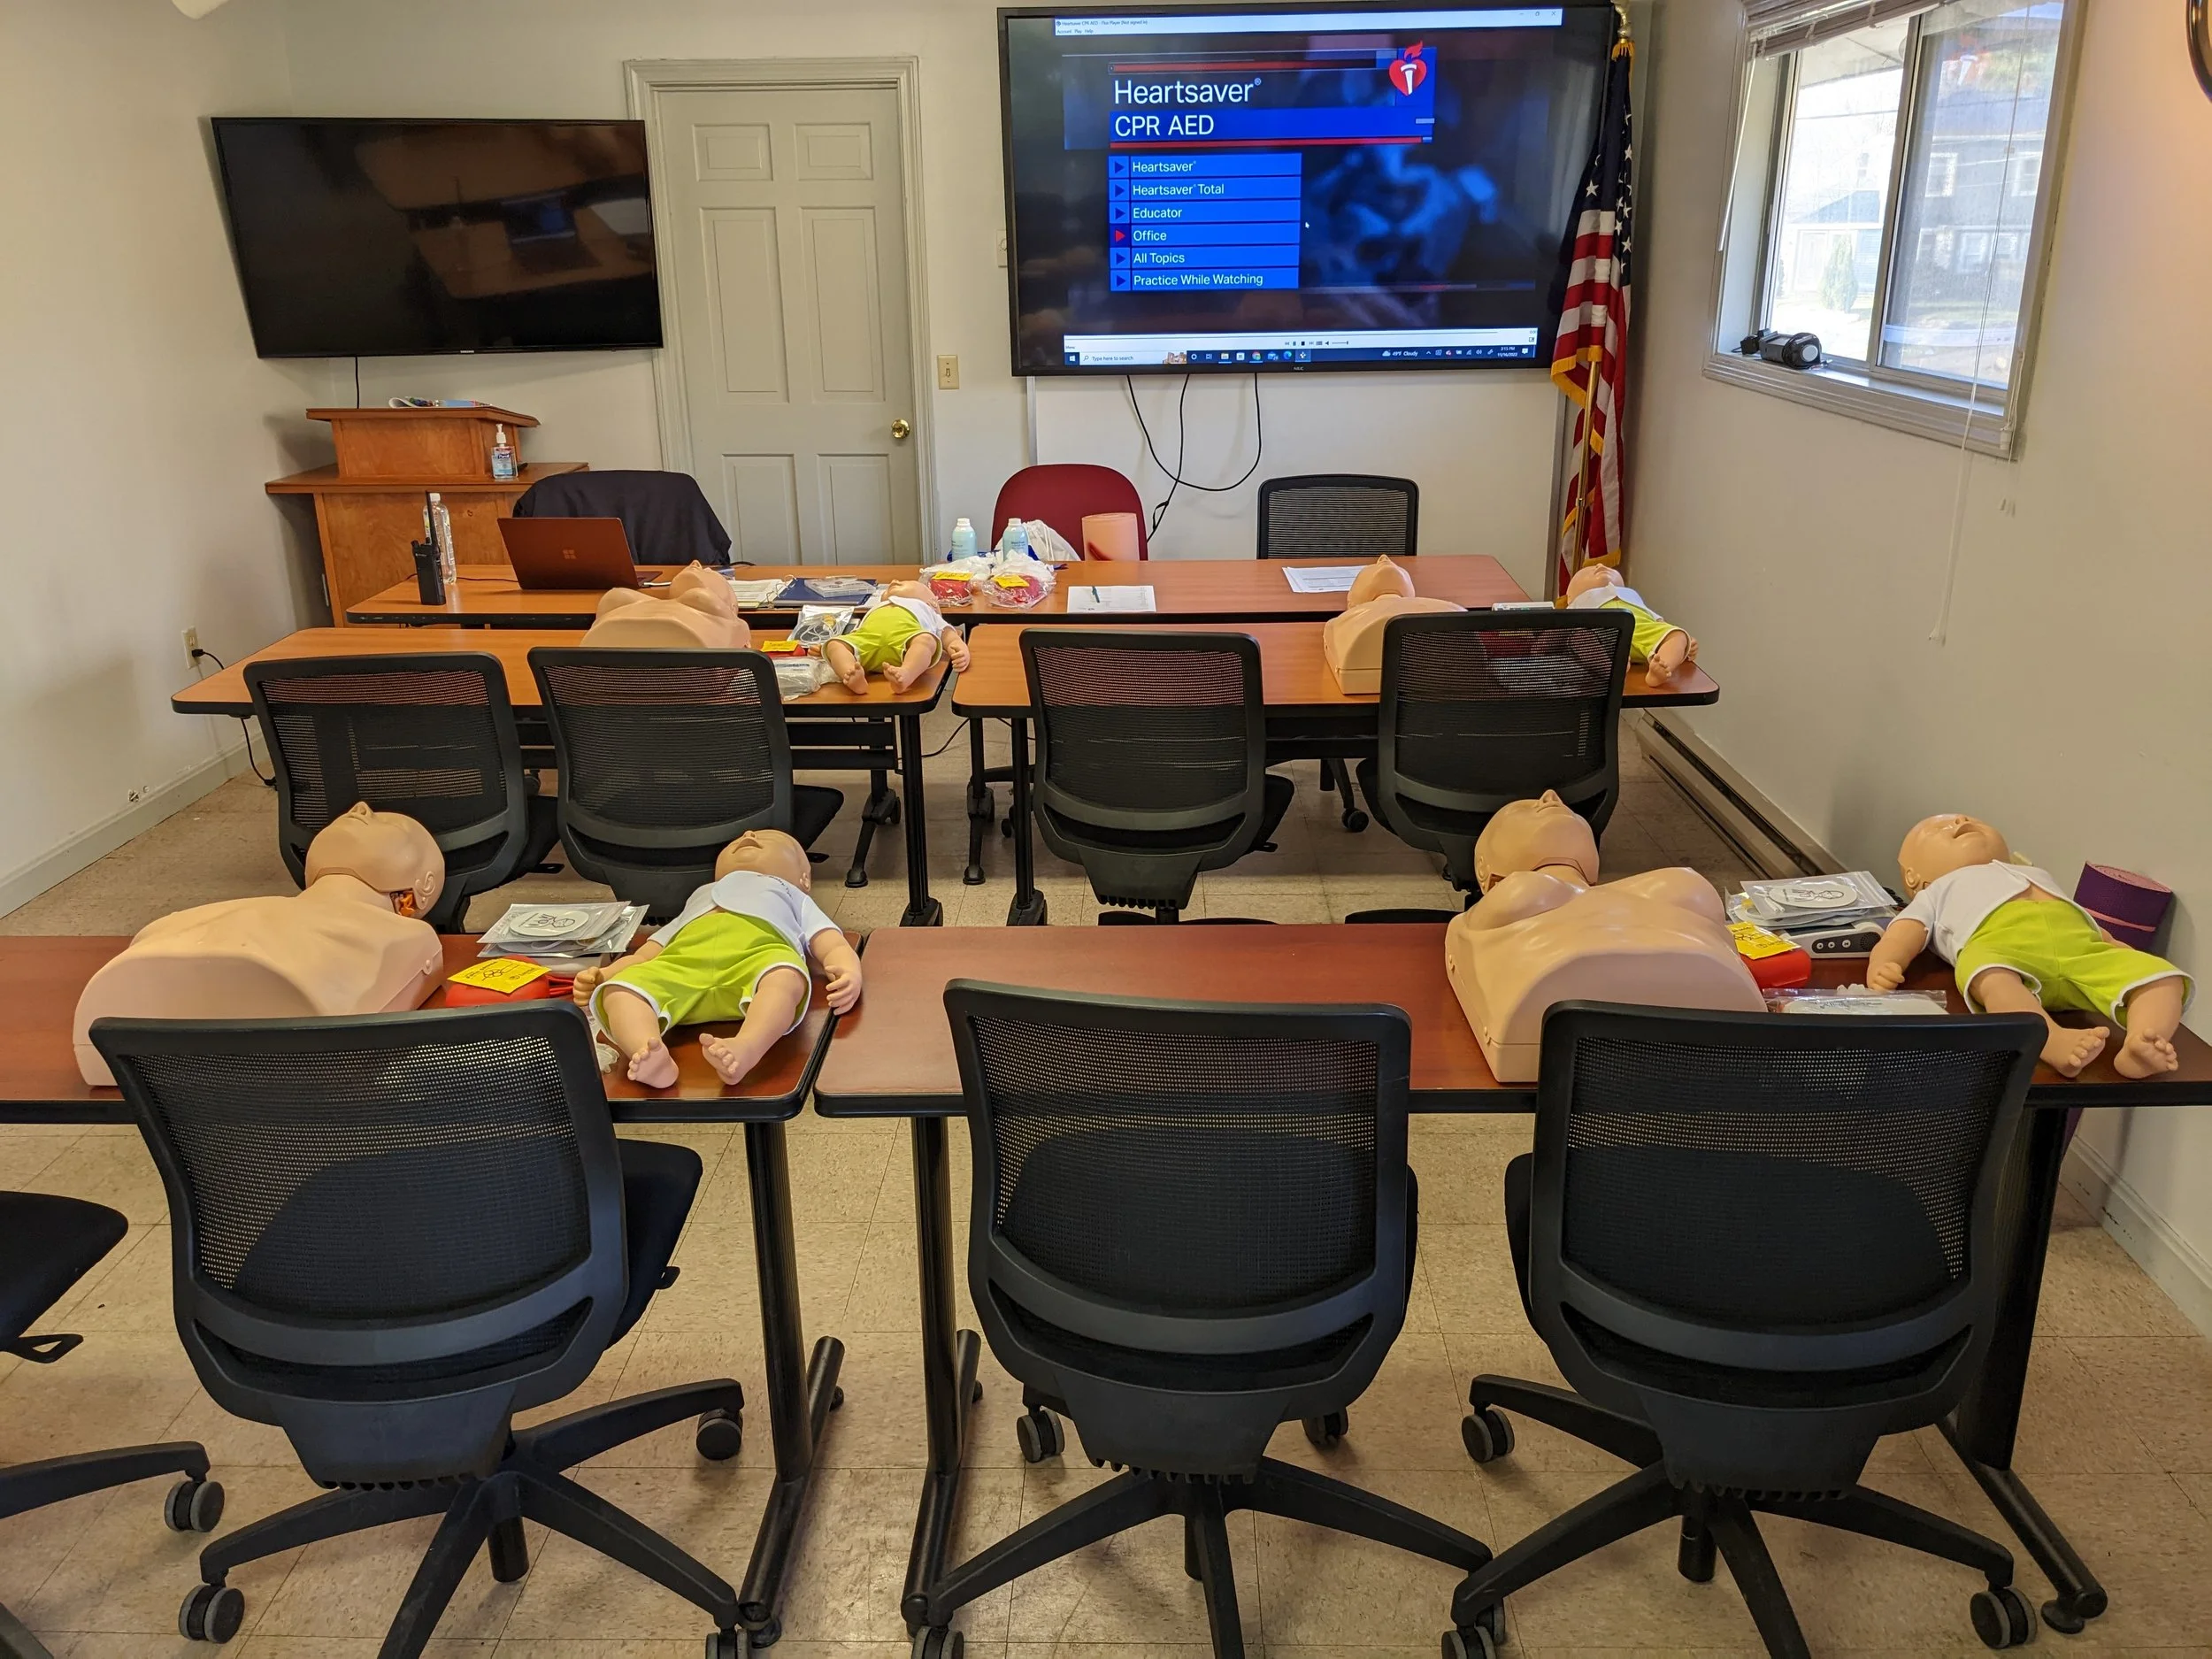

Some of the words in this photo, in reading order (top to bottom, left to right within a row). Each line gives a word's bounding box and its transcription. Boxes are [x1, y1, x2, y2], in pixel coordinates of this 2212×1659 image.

[1115, 115, 1160, 136] CPR
[1168, 114, 1215, 135] AED
[1197, 183, 1225, 195] Total
[1133, 208, 1182, 219] Educator
[1133, 230, 1167, 242] Office
[1133, 253, 1148, 264] All
[1149, 252, 1185, 265] Topics
[1133, 275, 1178, 286] Practice
[1180, 274, 1210, 285] While
[1212, 273, 1263, 286] Watching
